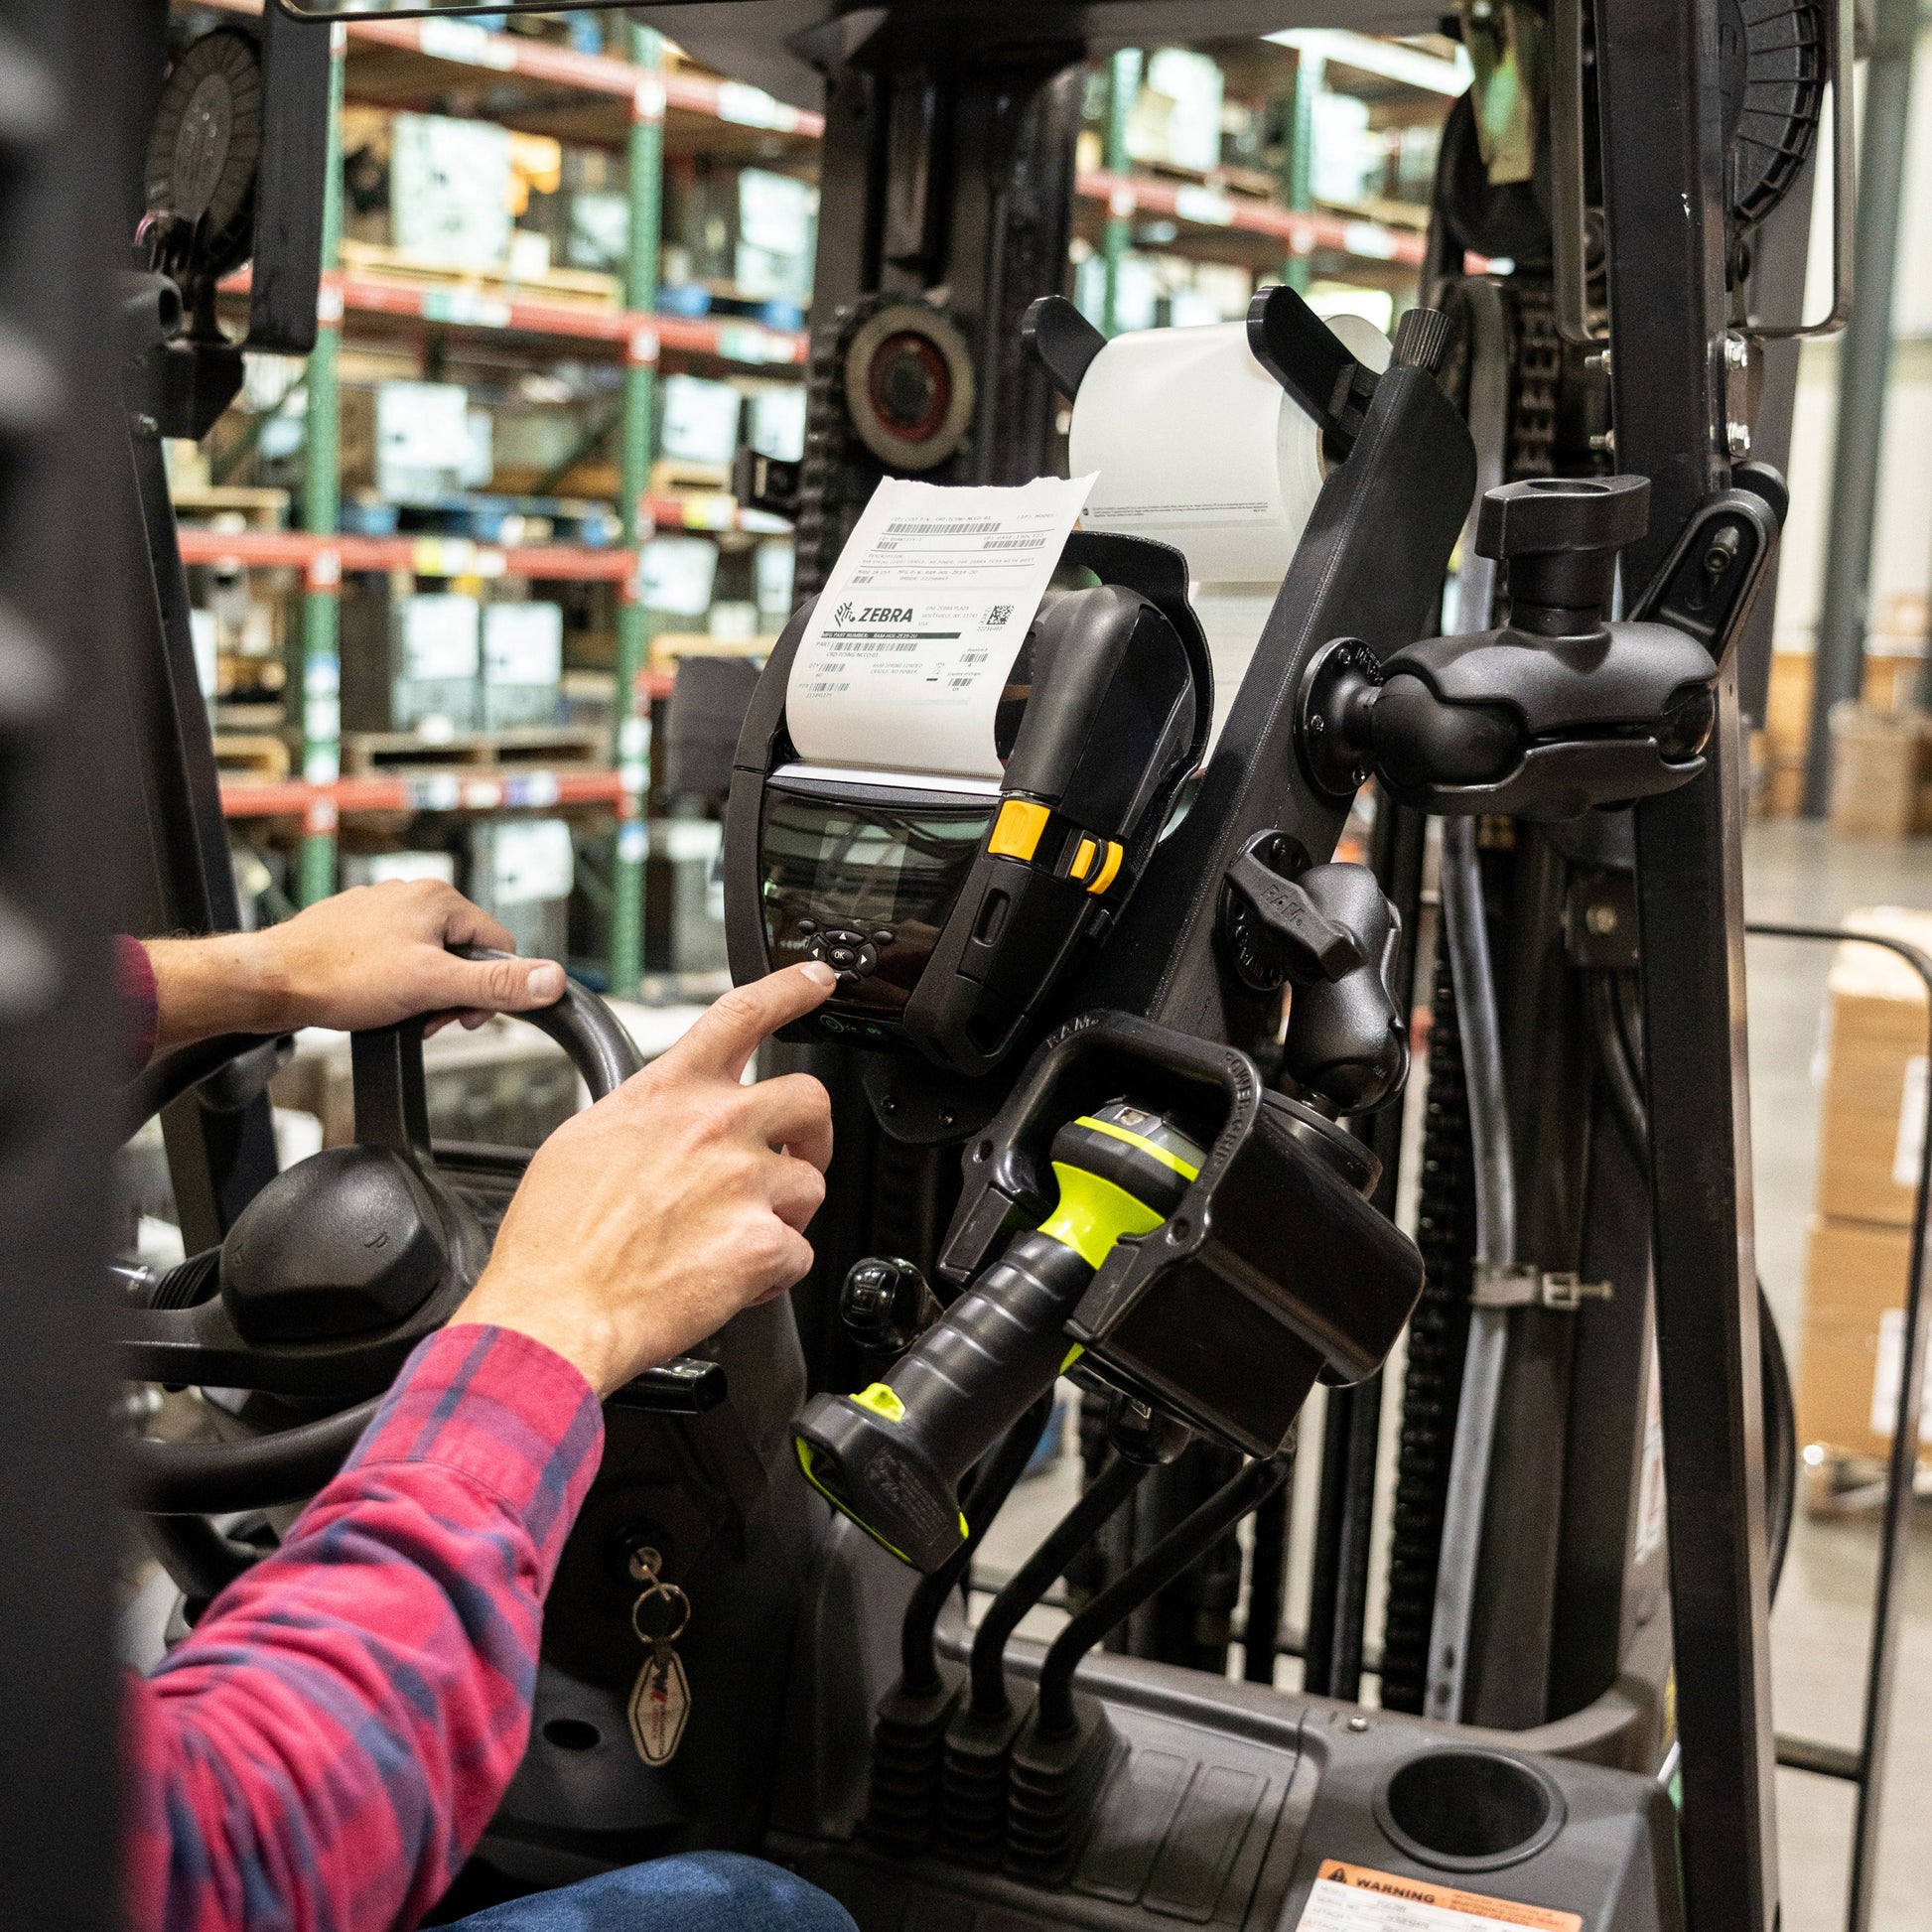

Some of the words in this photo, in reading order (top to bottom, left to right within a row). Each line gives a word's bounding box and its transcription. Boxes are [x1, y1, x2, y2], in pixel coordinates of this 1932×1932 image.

[858, 608, 913, 622] ZEBRA
[834, 950, 845, 960] OK
[1356, 1876, 1436, 1904] WARNING
